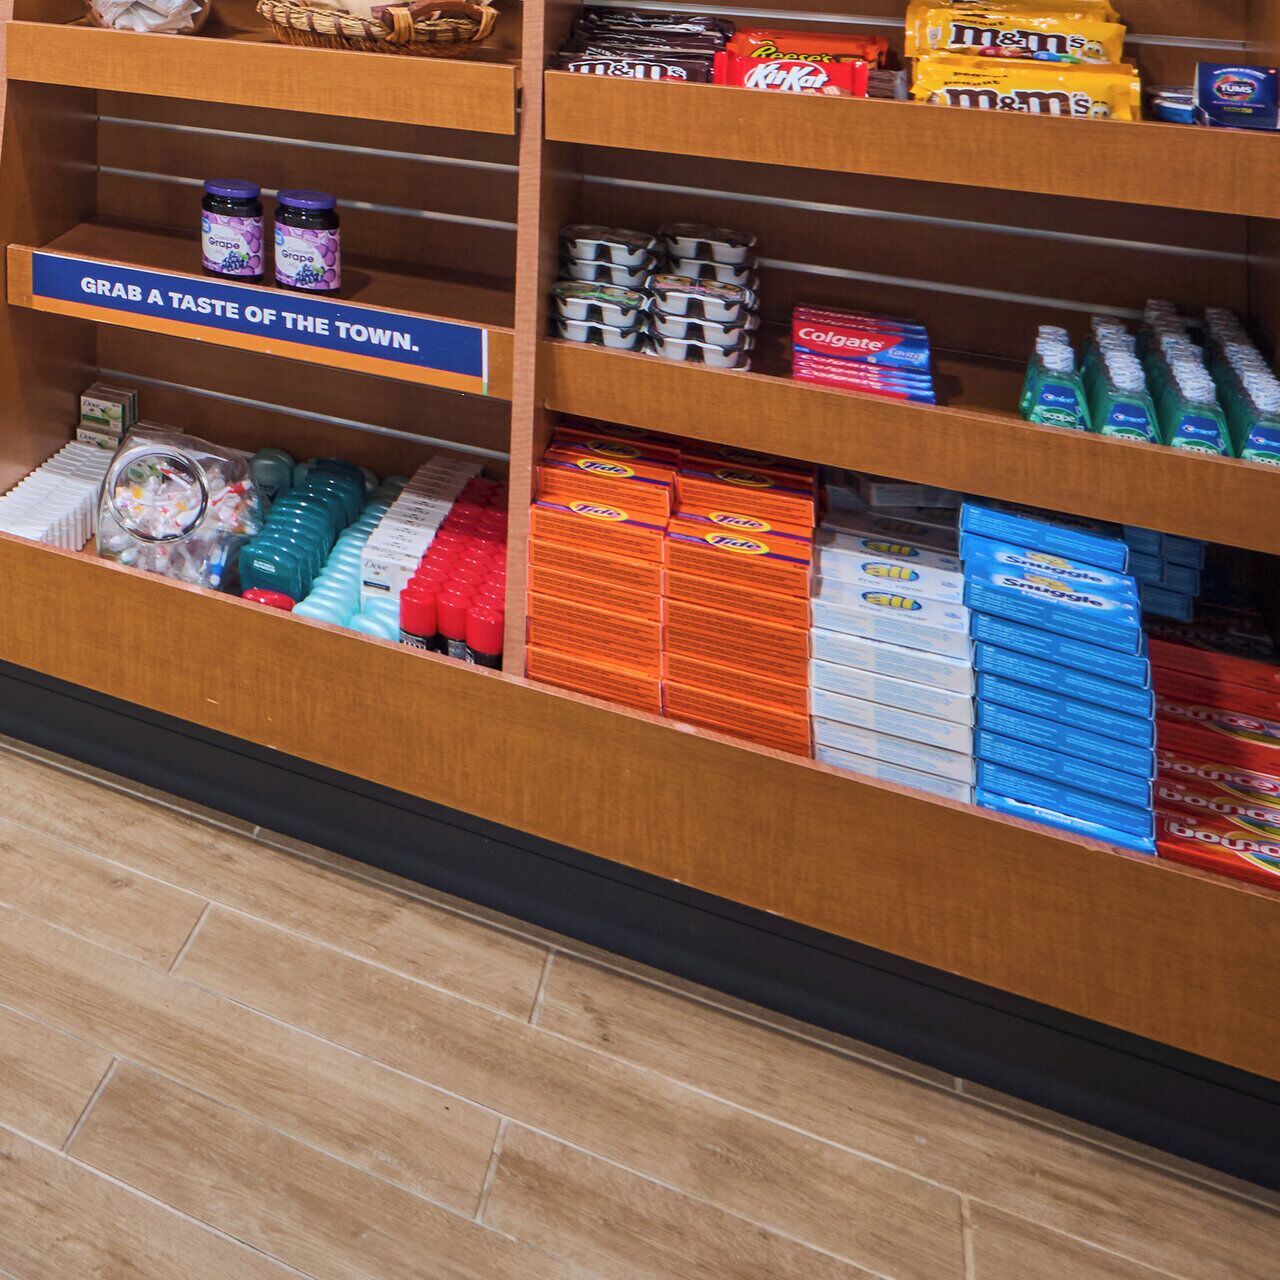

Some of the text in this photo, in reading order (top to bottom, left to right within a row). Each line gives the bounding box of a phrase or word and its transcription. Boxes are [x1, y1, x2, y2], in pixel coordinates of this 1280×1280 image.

[950, 23, 1086, 53] m&m's
[1221, 84, 1253, 94] TUMS
[208, 237, 240, 251] Grape
[281, 249, 314, 263] Grape
[80, 276, 420, 352] GRAB A TASTE OF THE TOWN.
[798, 327, 883, 351] Colgate
[83, 401, 100, 409] Dove
[583, 461, 628, 476] Tide
[575, 504, 620, 519] Tide
[716, 515, 762, 529] Tide
[711, 536, 761, 551] Tide
[364, 560, 389, 572] Dove
[1004, 554, 1104, 584] Snuggle
[1001, 577, 1104, 609] Snuggle
